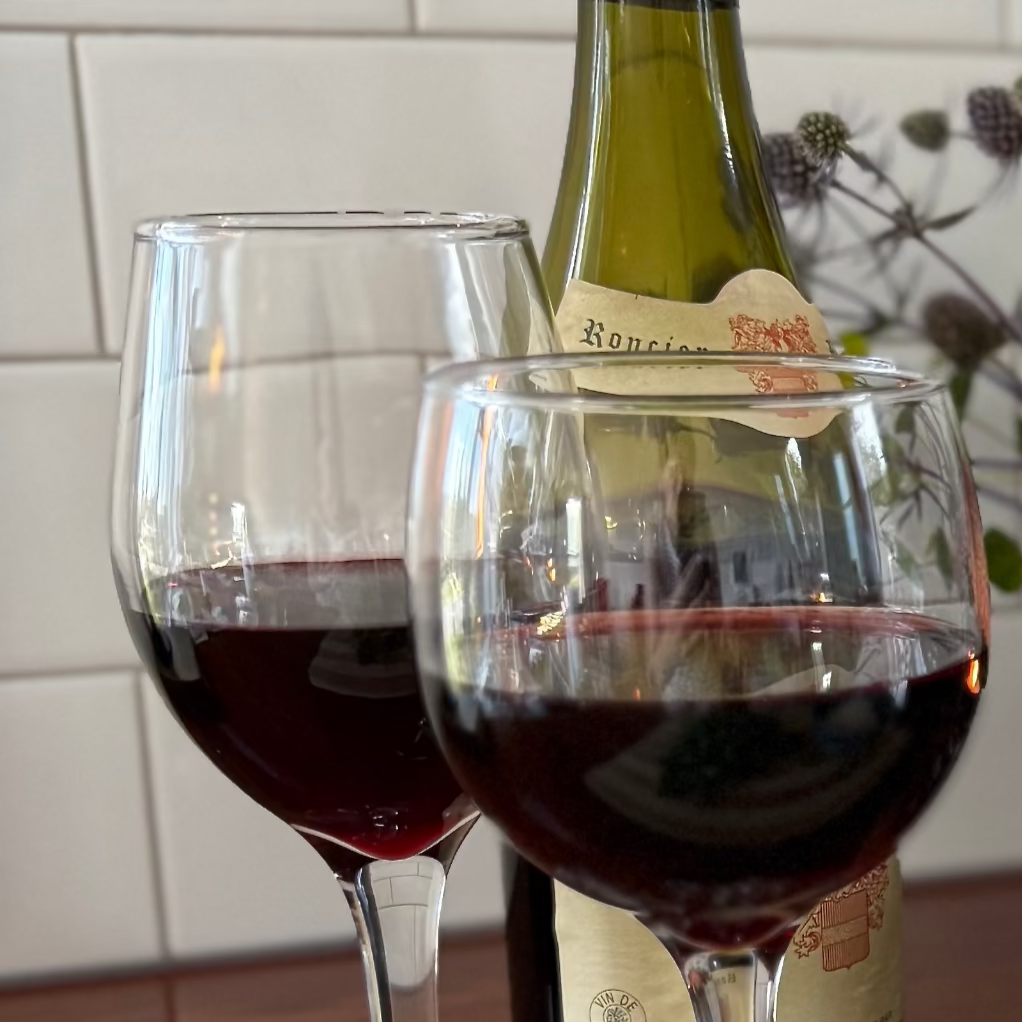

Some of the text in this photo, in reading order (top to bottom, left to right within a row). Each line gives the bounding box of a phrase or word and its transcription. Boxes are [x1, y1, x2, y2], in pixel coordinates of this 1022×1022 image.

[580, 319, 708, 352] Ronci
[595, 992, 638, 1011] VIN DE
